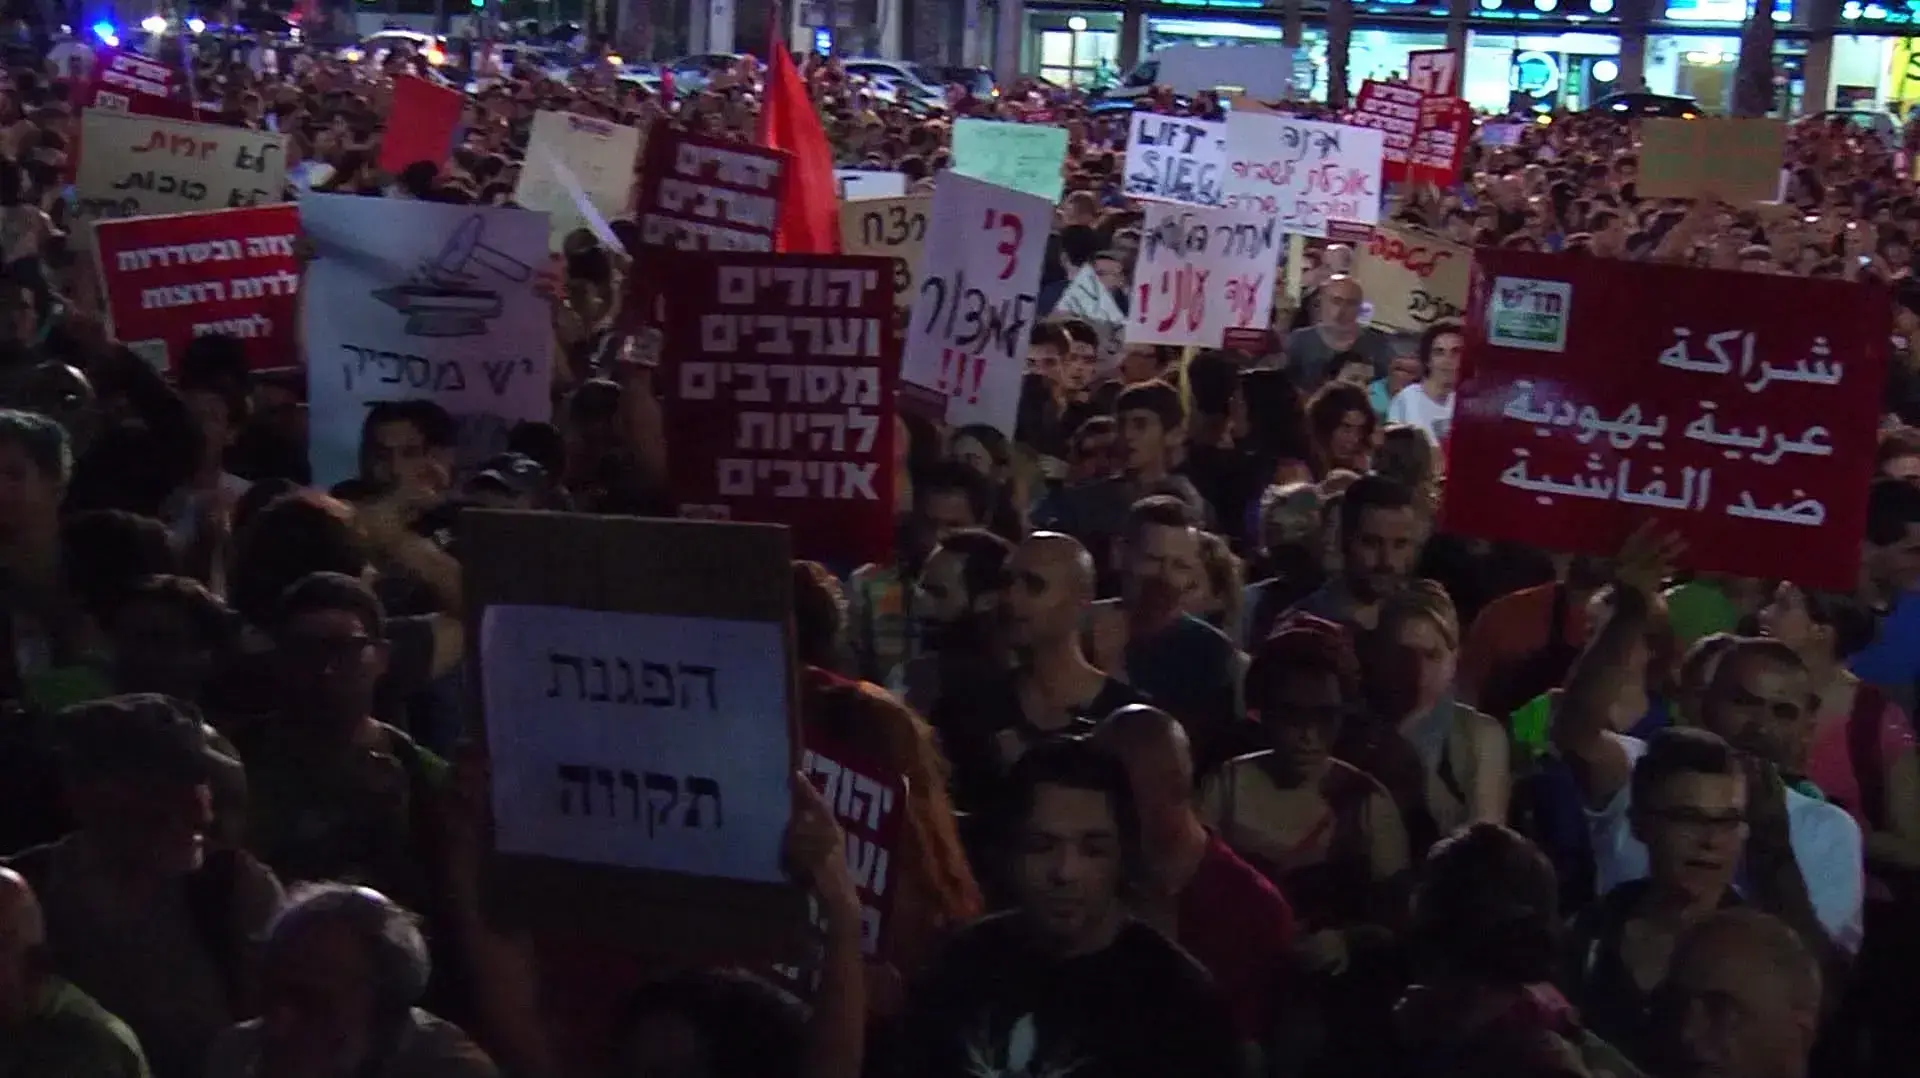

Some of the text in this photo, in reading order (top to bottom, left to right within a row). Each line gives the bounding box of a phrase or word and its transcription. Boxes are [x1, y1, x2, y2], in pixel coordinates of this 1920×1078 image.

[718, 266, 879, 307] יהודים
[701, 314, 881, 357] וערבים
[1657, 326, 1844, 394] شراكة
[341, 344, 533, 395] יש מספיק
[679, 362, 880, 406] מסרבים
[737, 407, 880, 452] להיות
[1503, 380, 1834, 465] عربية يهودية
[718, 458, 881, 500] אויבים
[1499, 447, 1828, 526] ضد الفاشية
[546, 653, 718, 710] הפגנת
[558, 764, 723, 839] תקווה
